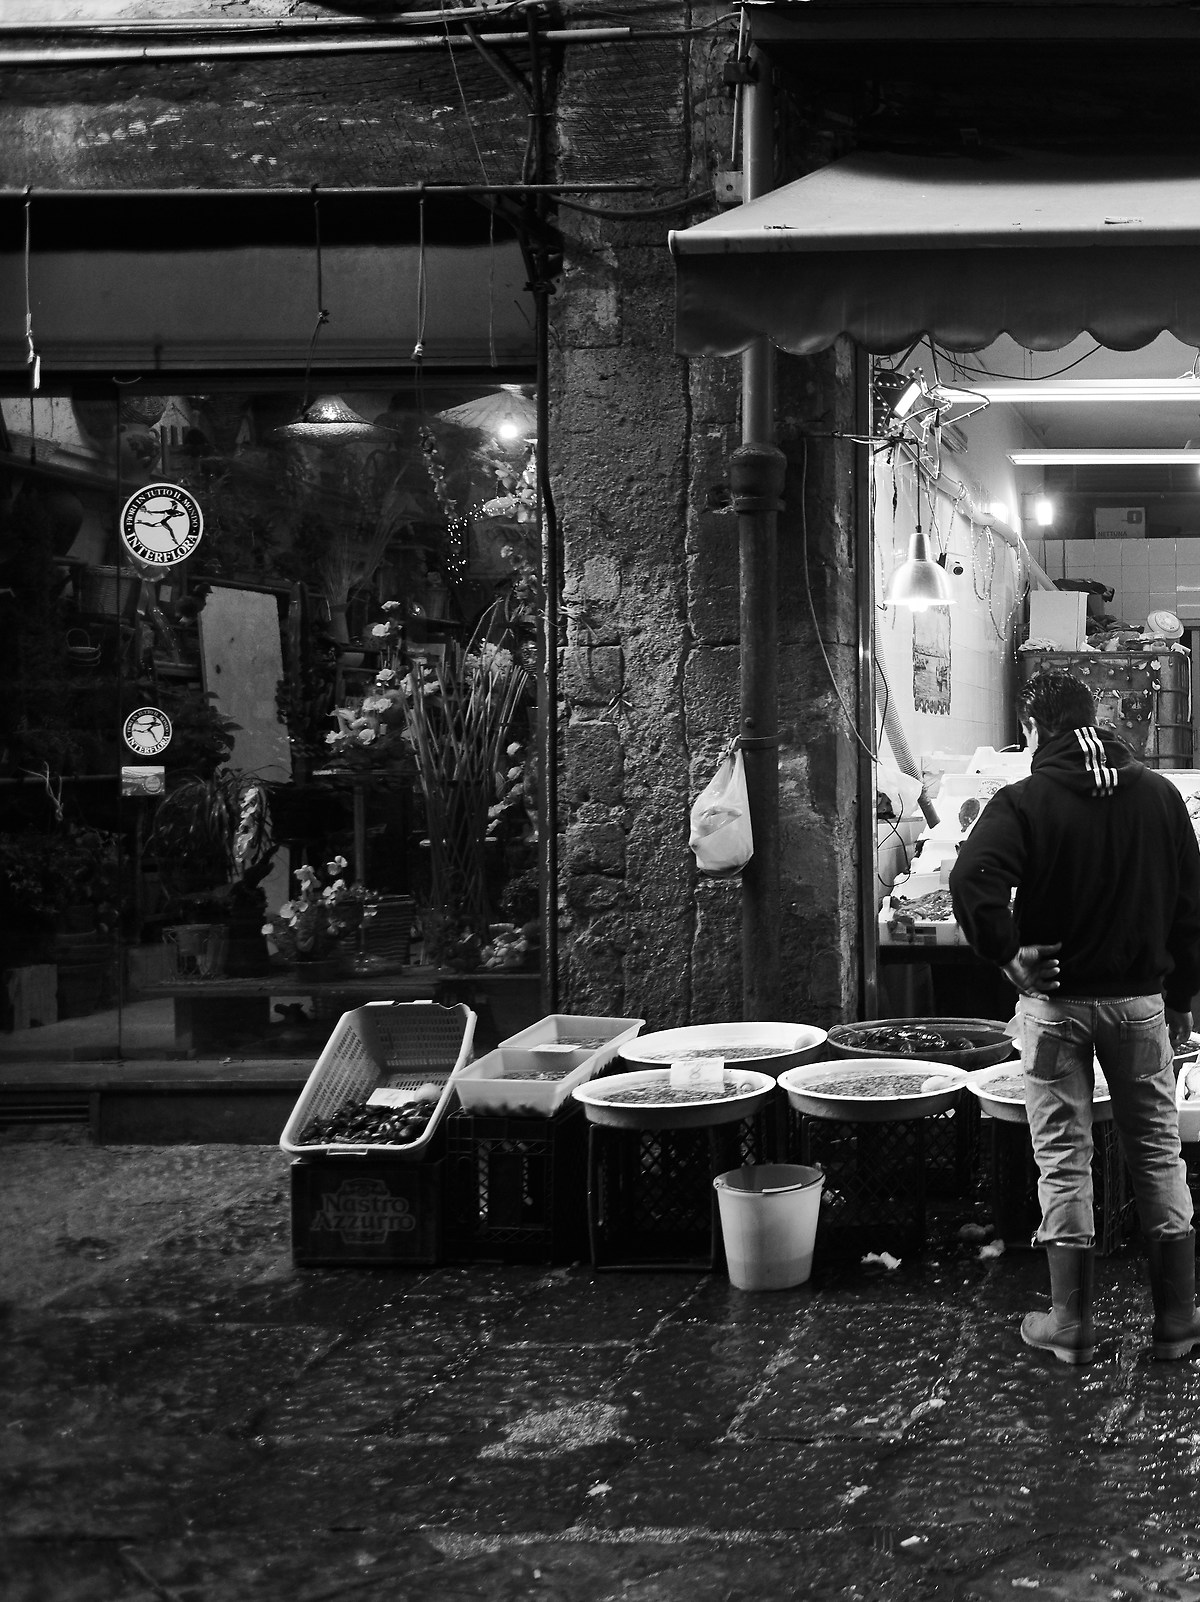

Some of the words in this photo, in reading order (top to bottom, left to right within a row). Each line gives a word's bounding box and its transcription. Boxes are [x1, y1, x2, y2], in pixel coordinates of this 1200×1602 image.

[126, 504, 139, 526] FIORI
[136, 495, 146, 505] IN
[146, 488, 173, 498] TUTTO
[173, 493, 182, 501] IL
[182, 498, 199, 528] MONDO
[126, 532, 199, 563] INTERFLORA
[127, 736, 170, 754] INTERFLORA
[321, 1194, 409, 1215] Nastro
[310, 1211, 415, 1231] Azzurro
